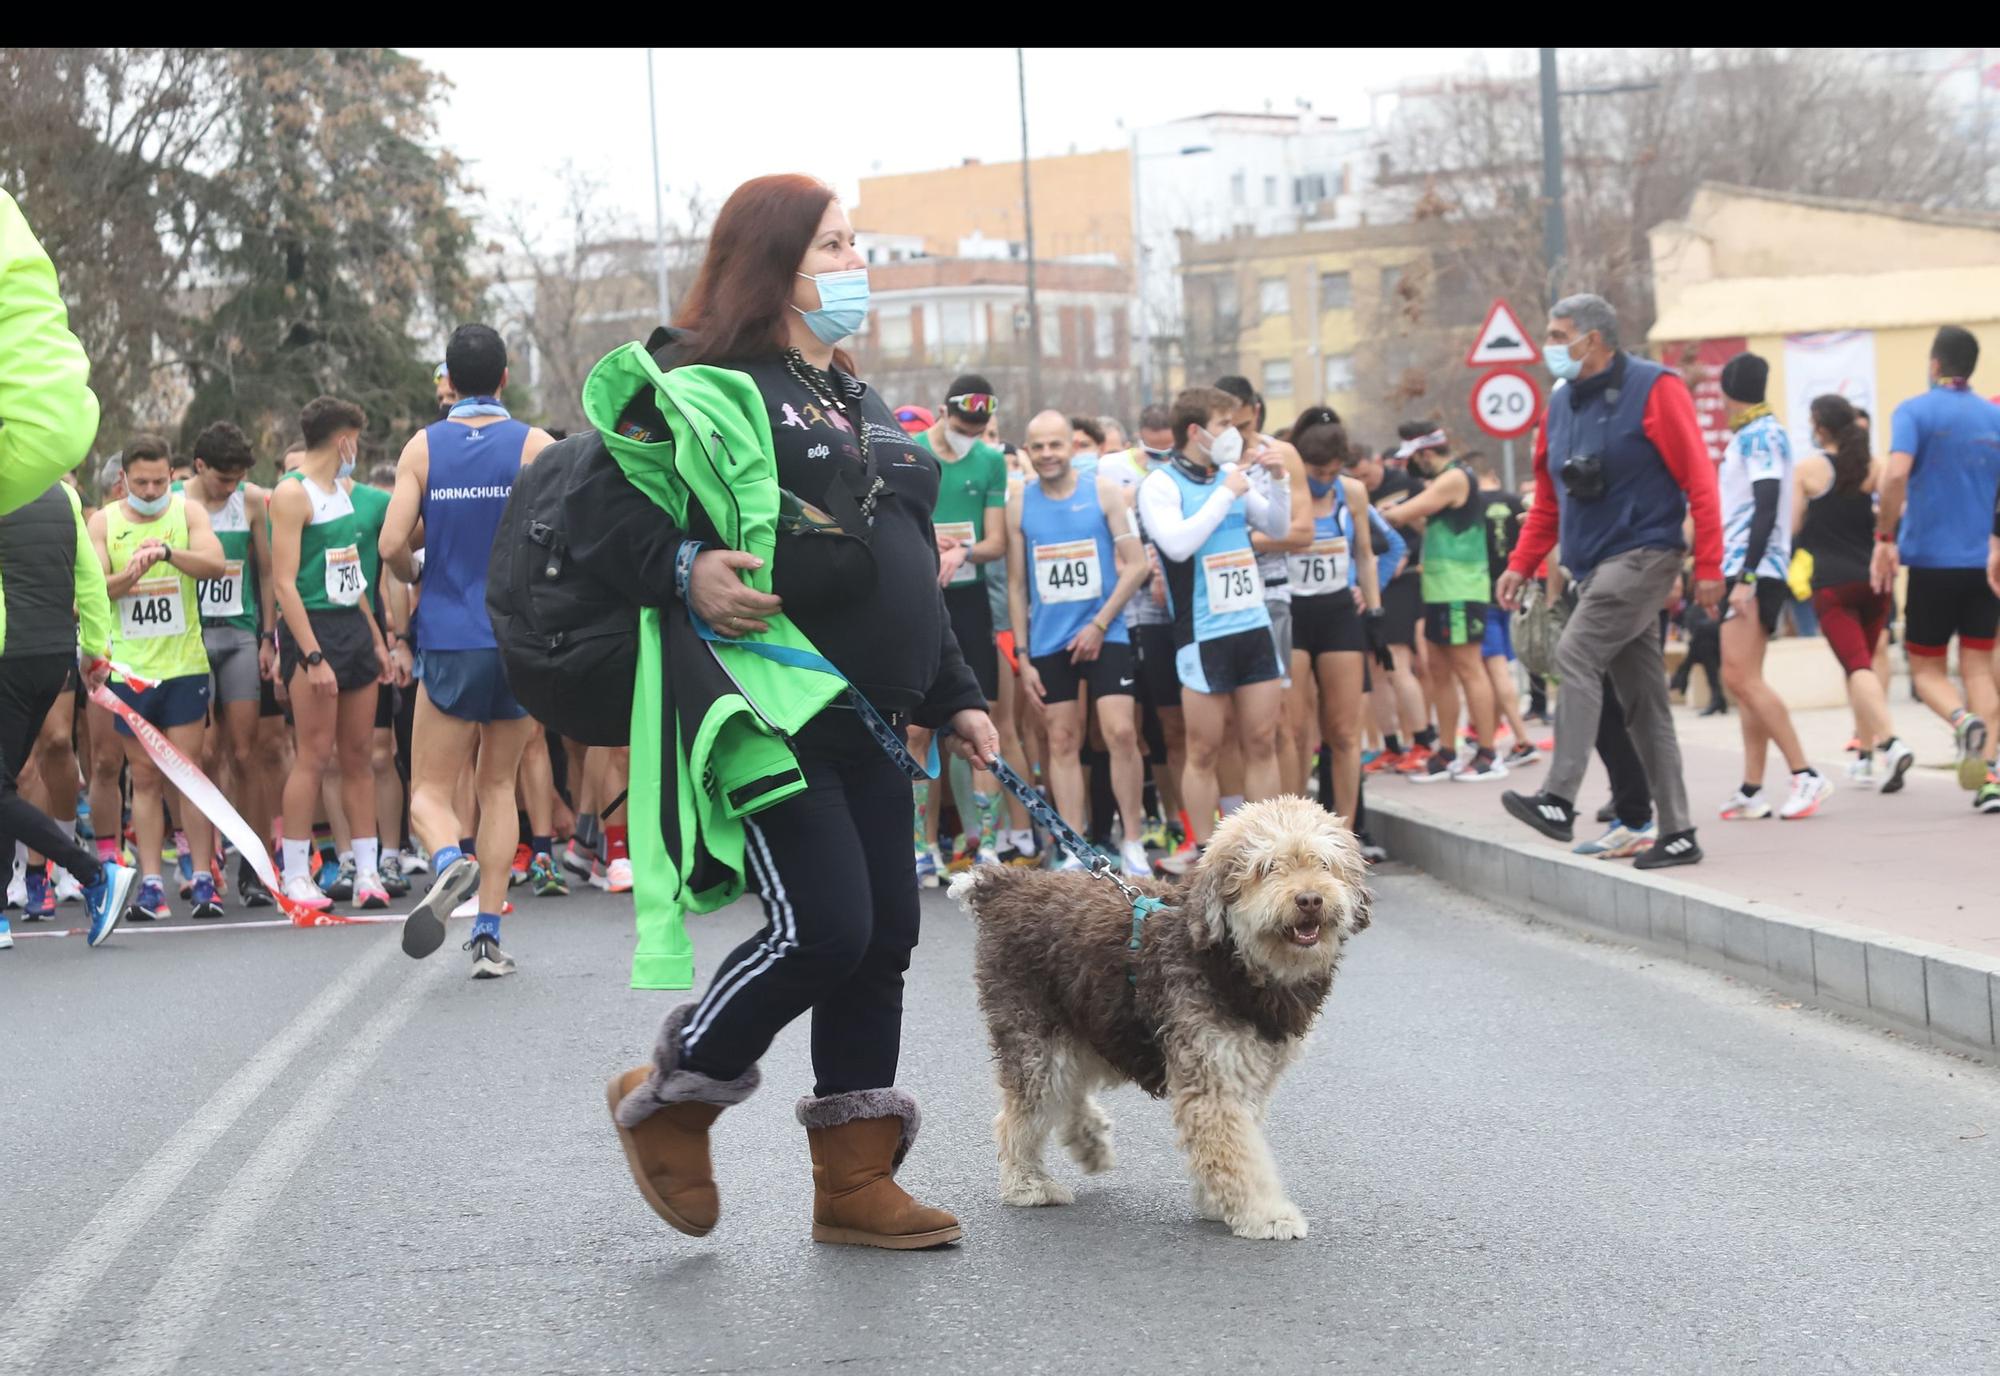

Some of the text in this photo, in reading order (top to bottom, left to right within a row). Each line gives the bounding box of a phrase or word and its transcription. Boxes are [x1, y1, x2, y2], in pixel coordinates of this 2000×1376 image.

[1487, 392, 1525, 415] 20
[807, 442, 831, 459] edp
[338, 564, 360, 593] 750
[1049, 561, 1089, 589] 449
[1220, 568, 1254, 599] 735
[1300, 556, 1337, 584] 761
[199, 578, 233, 603] 760
[132, 597, 173, 625] 448
